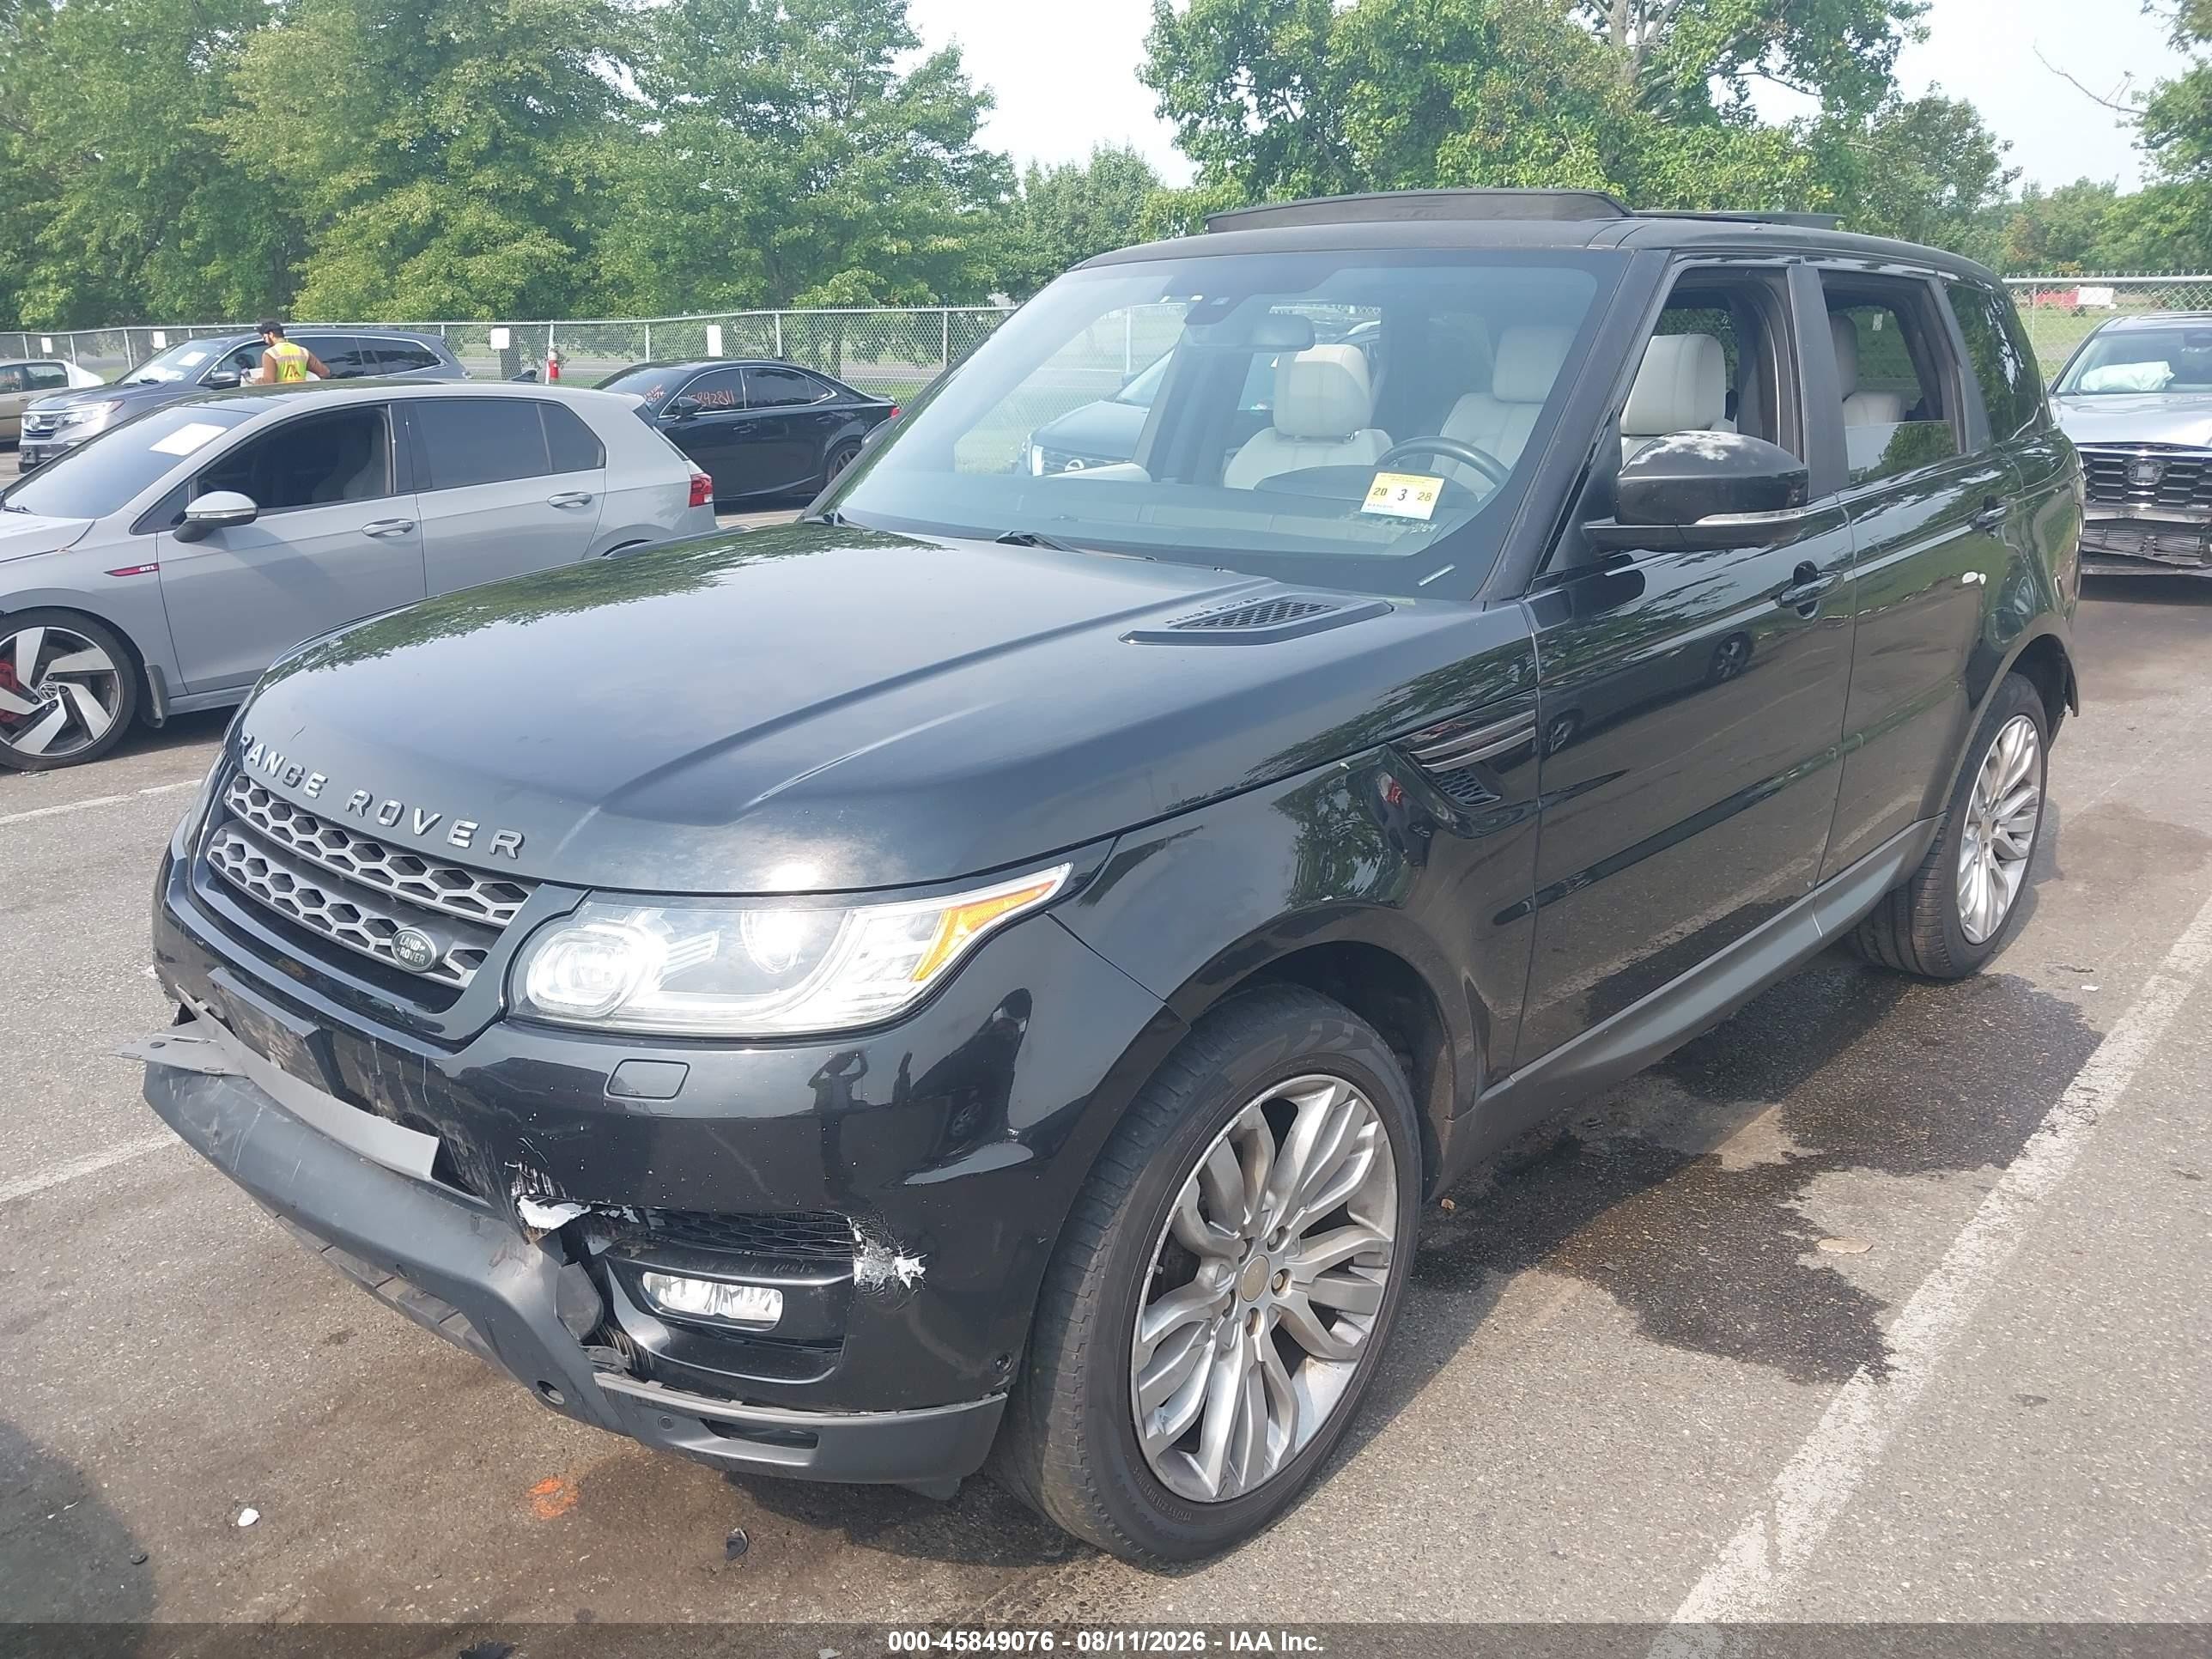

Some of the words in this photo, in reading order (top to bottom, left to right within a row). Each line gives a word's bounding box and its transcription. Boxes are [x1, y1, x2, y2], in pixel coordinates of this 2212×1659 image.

[1373, 487, 1388, 496] 20
[1397, 489, 1407, 501] 3
[238, 732, 328, 799] RANGE
[344, 788, 526, 860] ROVER
[399, 935, 421, 951] LAND
[399, 947, 426, 965] ROVER
